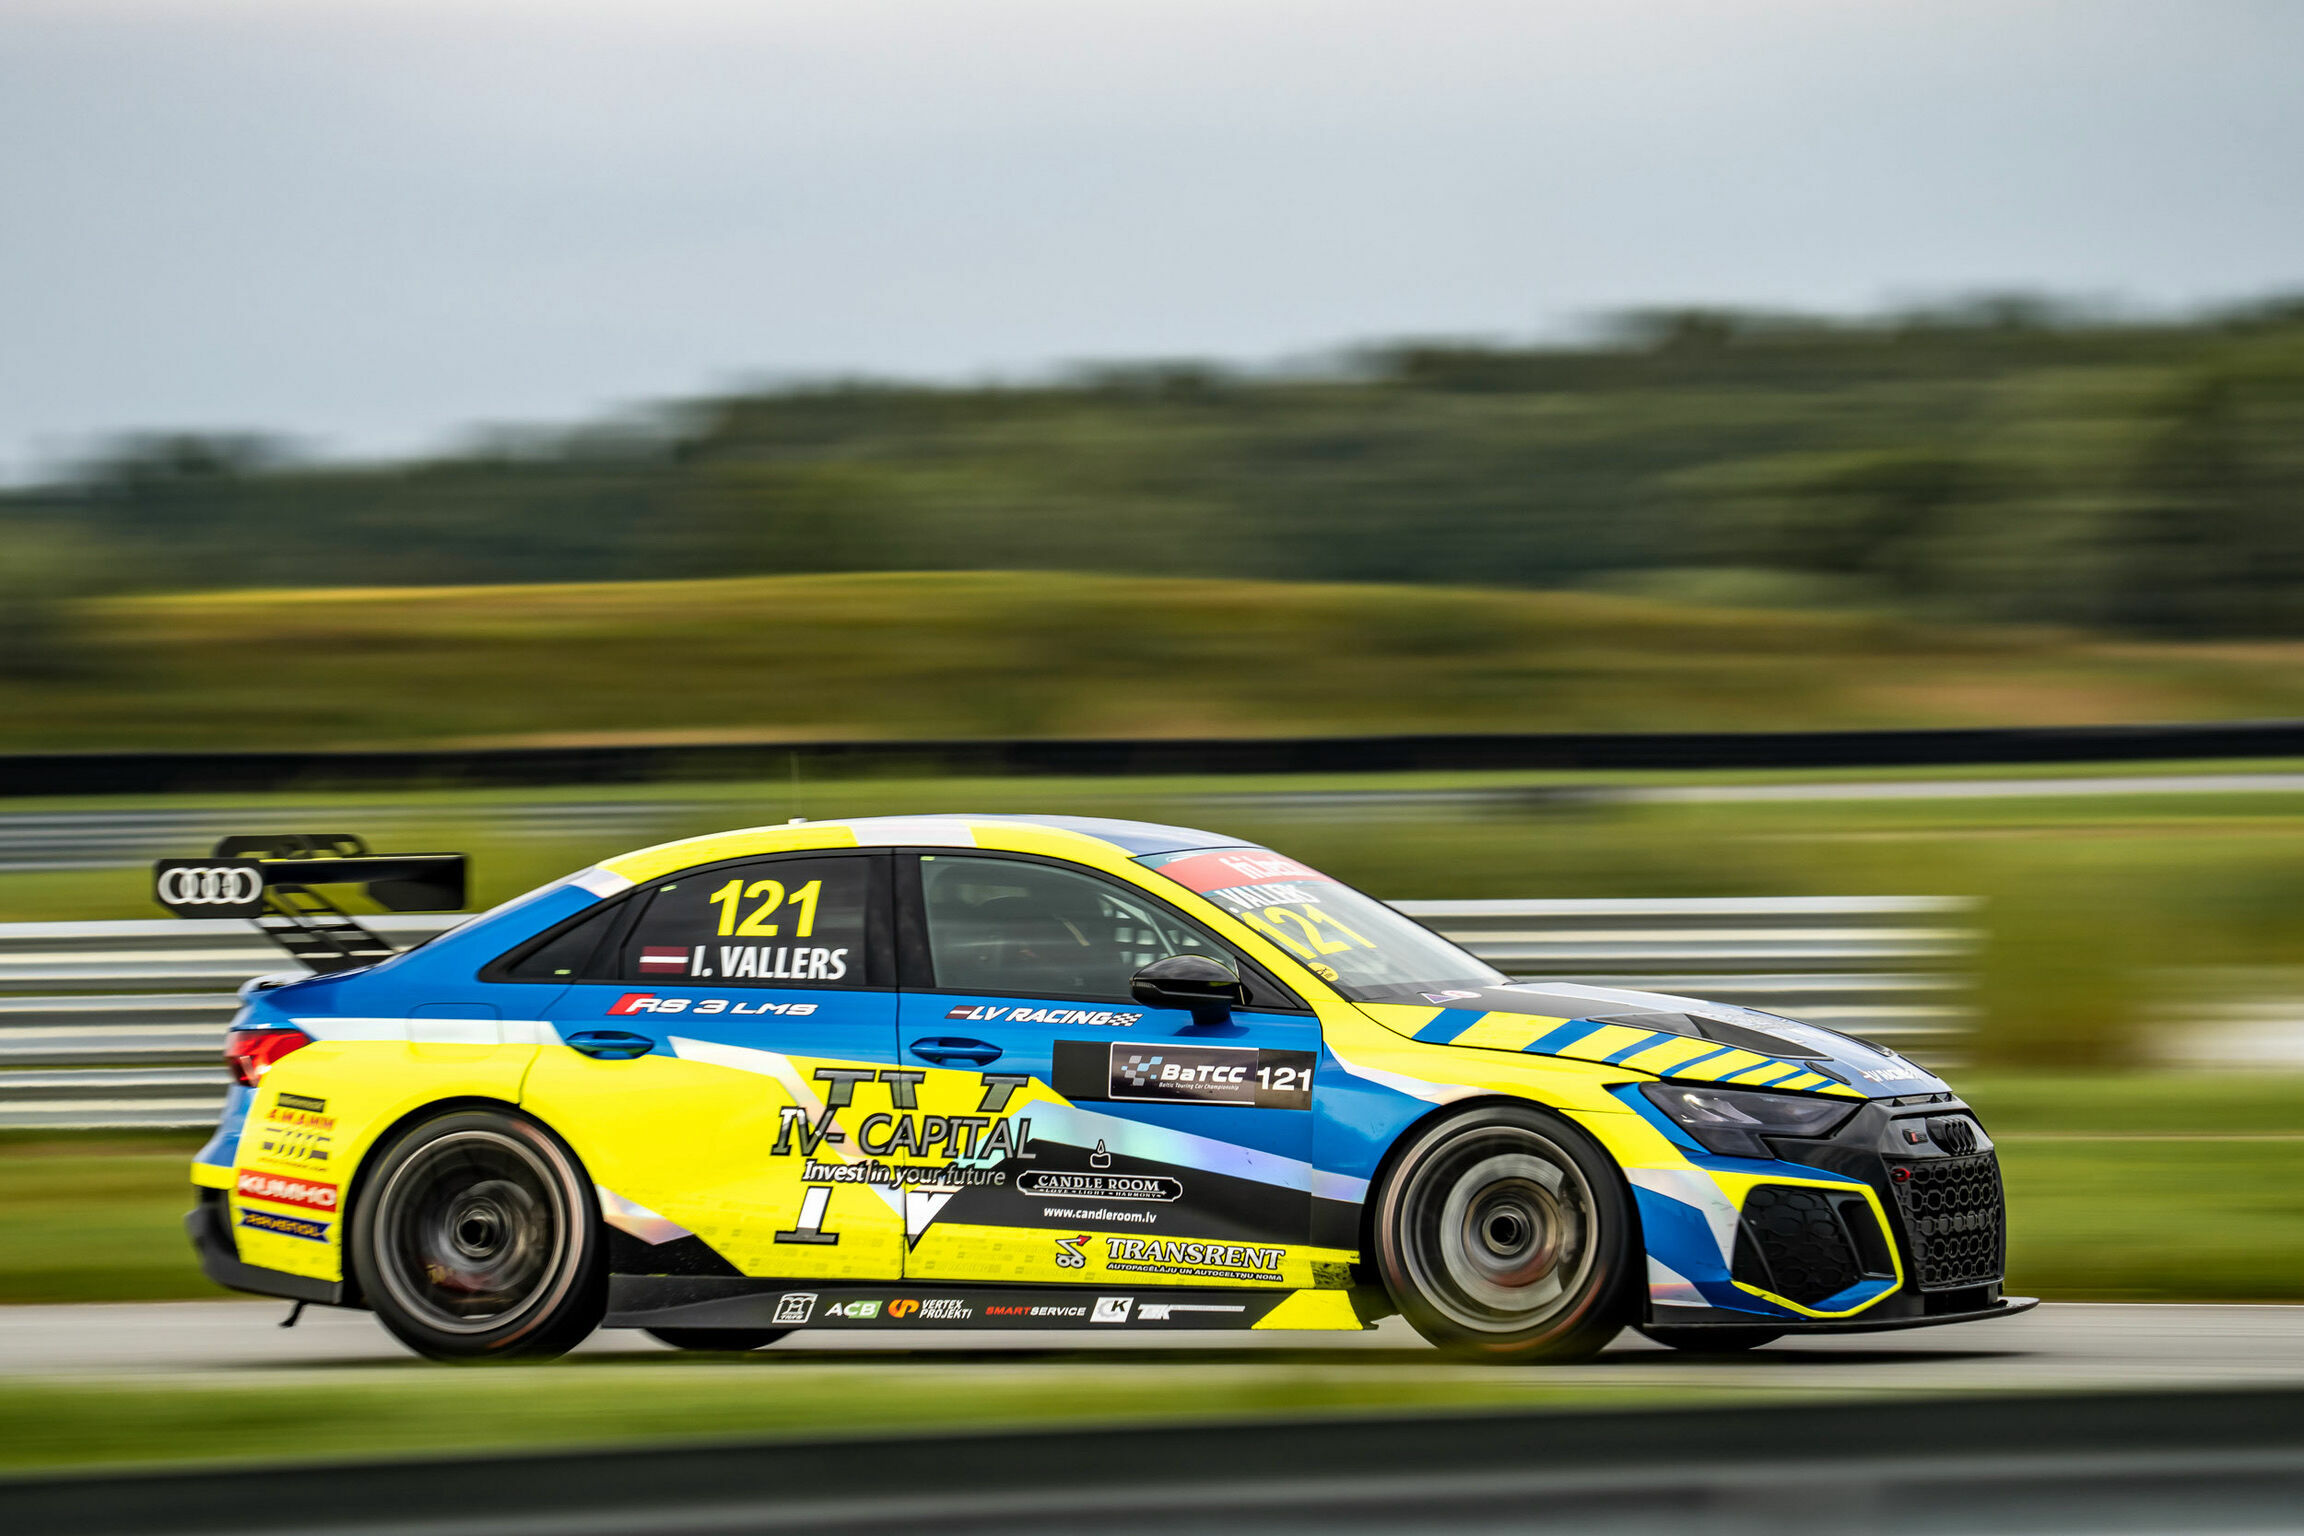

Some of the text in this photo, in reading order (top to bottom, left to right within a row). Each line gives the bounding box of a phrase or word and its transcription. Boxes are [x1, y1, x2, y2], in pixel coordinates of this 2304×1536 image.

[709, 879, 823, 938] 121
[1241, 903, 1378, 961] 121
[690, 945, 849, 980] I. VALLERS
[625, 998, 819, 1016] RS 3 LMS
[966, 1005, 1114, 1026] LV RACING
[1160, 1064, 1248, 1084] BaTCC
[1256, 1067, 1312, 1092] 121
[858, 1113, 1037, 1160] CAPITAL
[801, 1158, 1006, 1189] Invest in your future
[1037, 1175, 1161, 1192] CANDLE ROOM
[1043, 1207, 1157, 1223] www.candleroom.lv
[1106, 1237, 1286, 1270] TRANSRENT
[1179, 1268, 1193, 1276] UN
[1255, 1273, 1284, 1282] NOMA
[824, 1301, 877, 1317] ACB
[919, 1308, 973, 1320] PROJEKTI
[921, 1299, 964, 1309] VERTEX
[985, 1305, 1087, 1317] SMARTSERVICE
